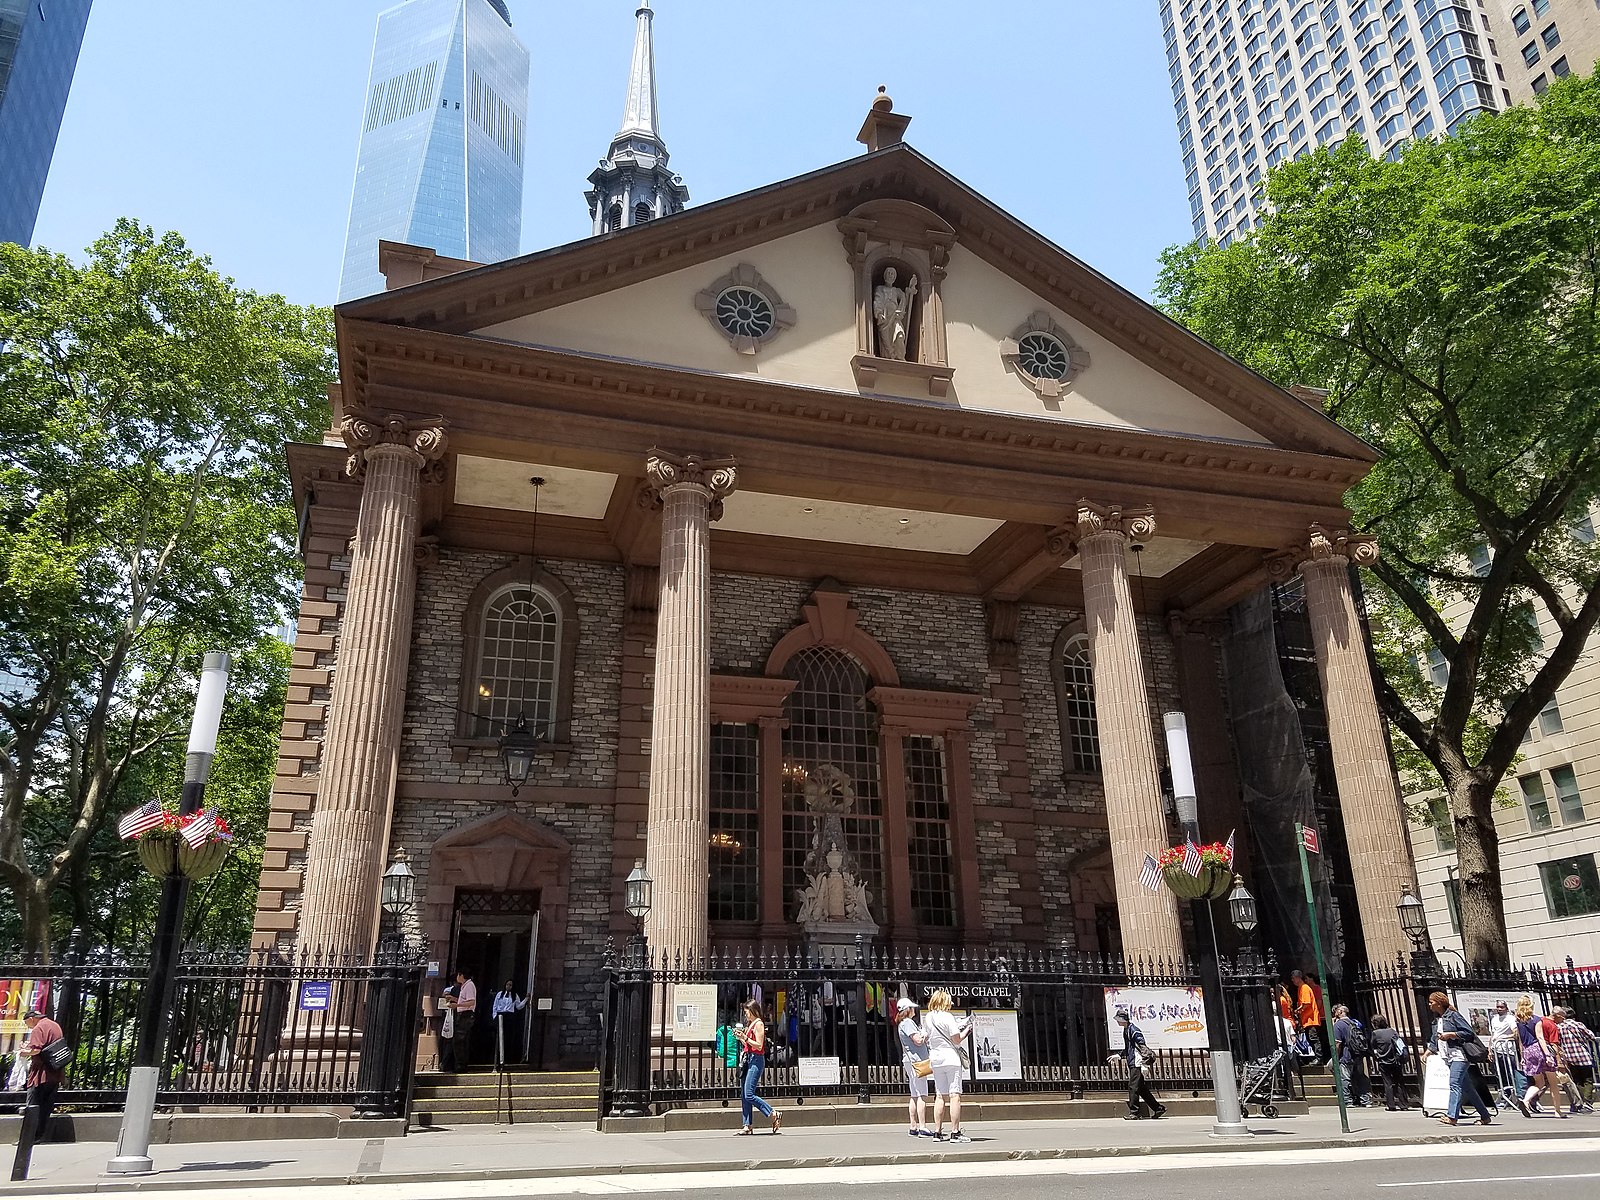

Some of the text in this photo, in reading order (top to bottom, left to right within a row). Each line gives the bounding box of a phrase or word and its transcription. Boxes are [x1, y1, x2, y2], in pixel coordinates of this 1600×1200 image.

[923, 986, 936, 996] ST
[971, 987, 1011, 997] CHAPEL
[1159, 1003, 1201, 1021] ARROW
